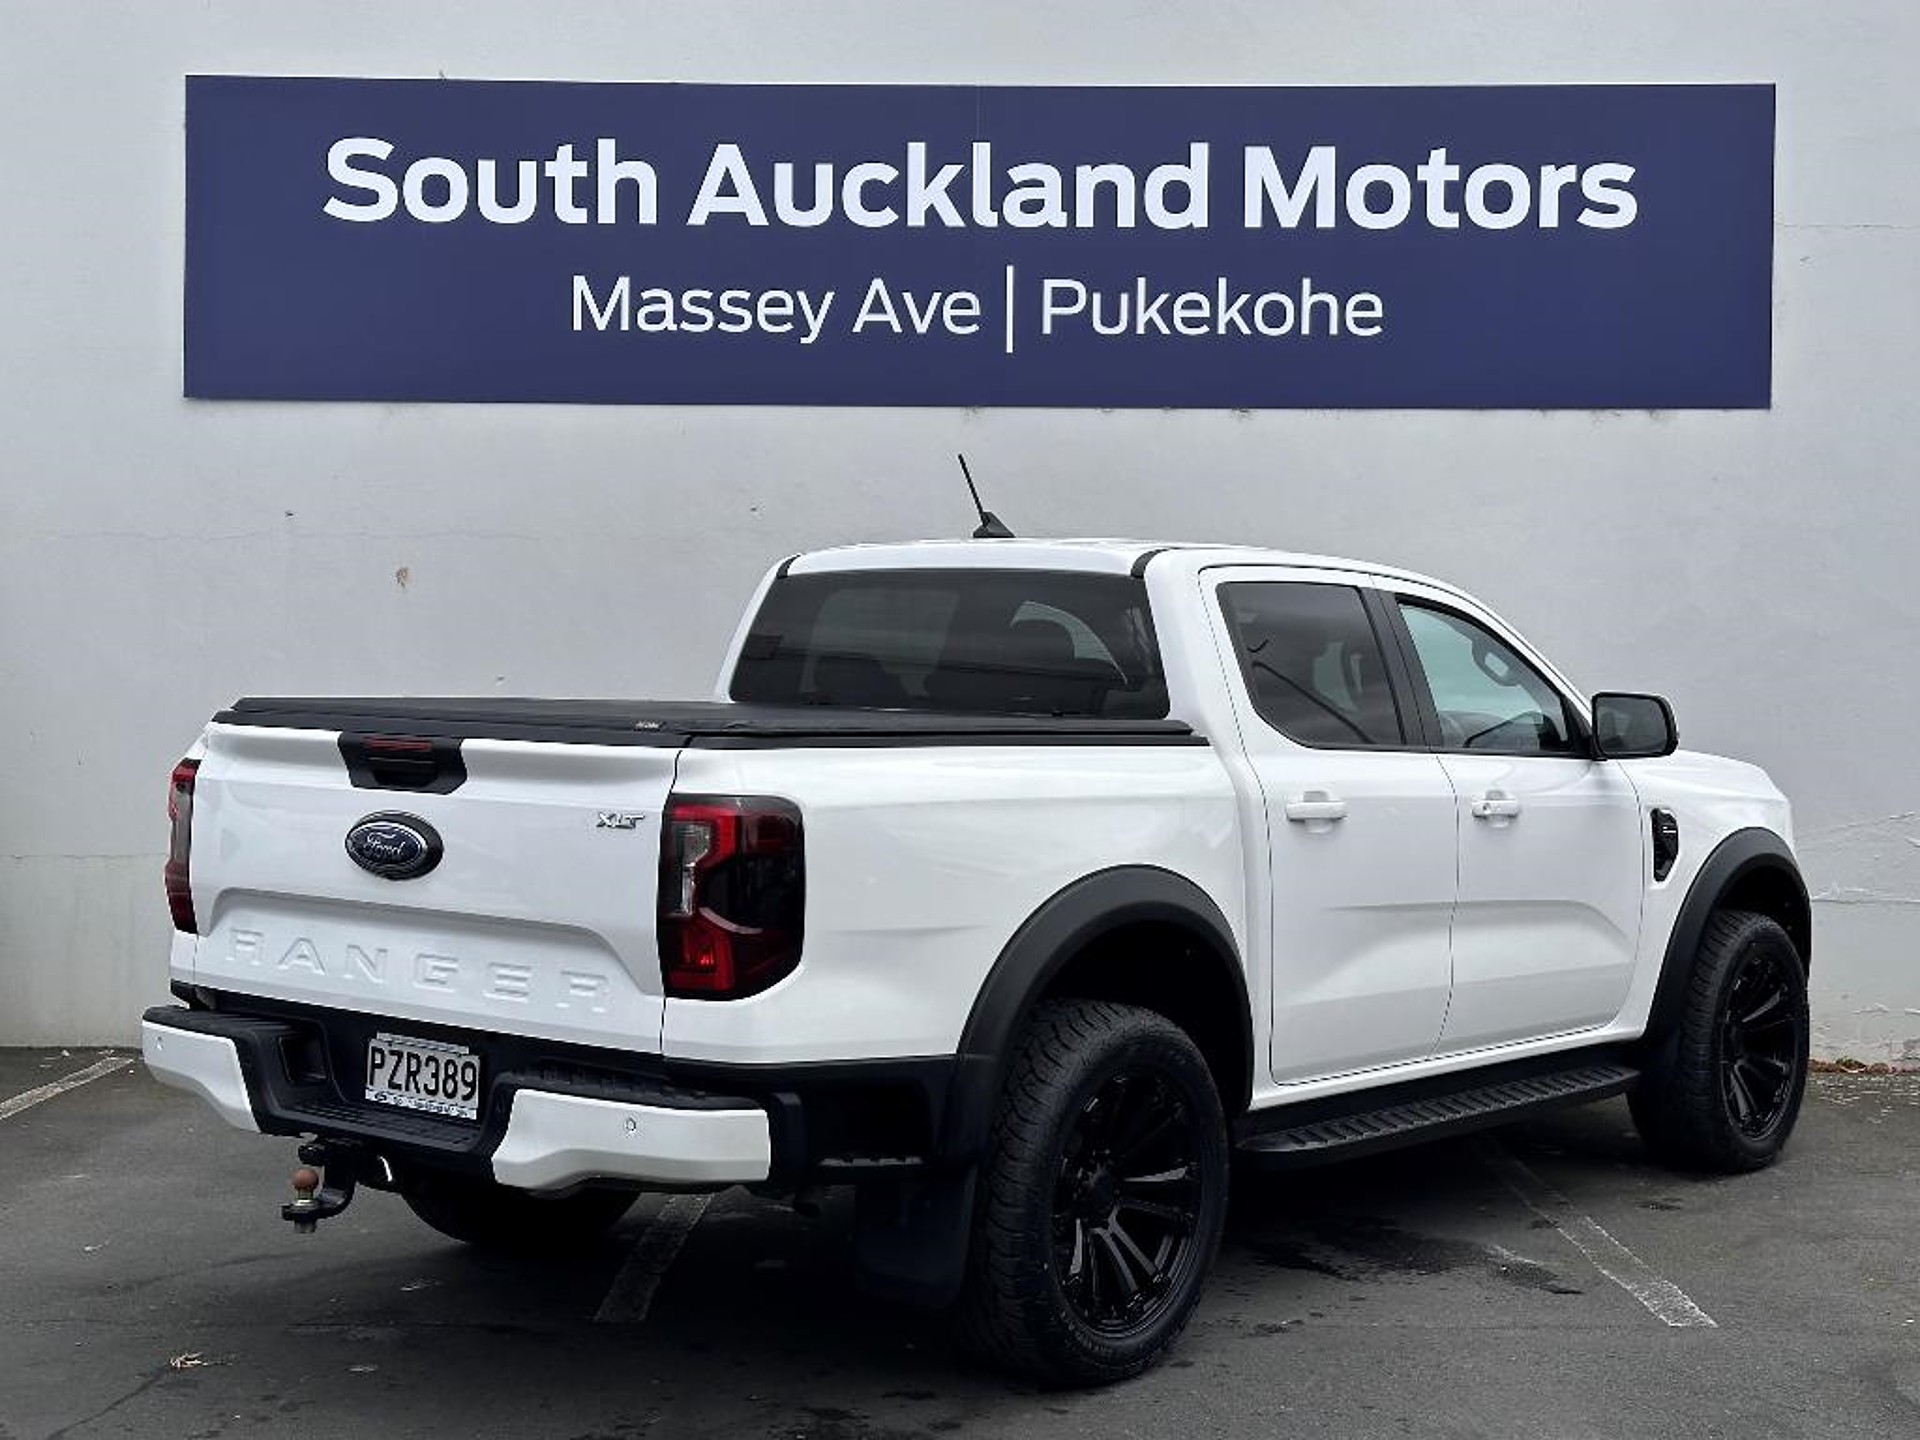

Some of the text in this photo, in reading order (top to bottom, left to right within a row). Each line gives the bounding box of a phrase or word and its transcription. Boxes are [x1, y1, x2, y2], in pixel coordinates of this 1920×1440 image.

[324, 138, 1637, 229] South Auckland Motors
[574, 276, 1382, 343] Massey Ave Pukekohe
[364, 831, 406, 857] Ford
[596, 811, 646, 829] XLT
[225, 927, 610, 1014] RANGER
[369, 1046, 477, 1101] PZR389
